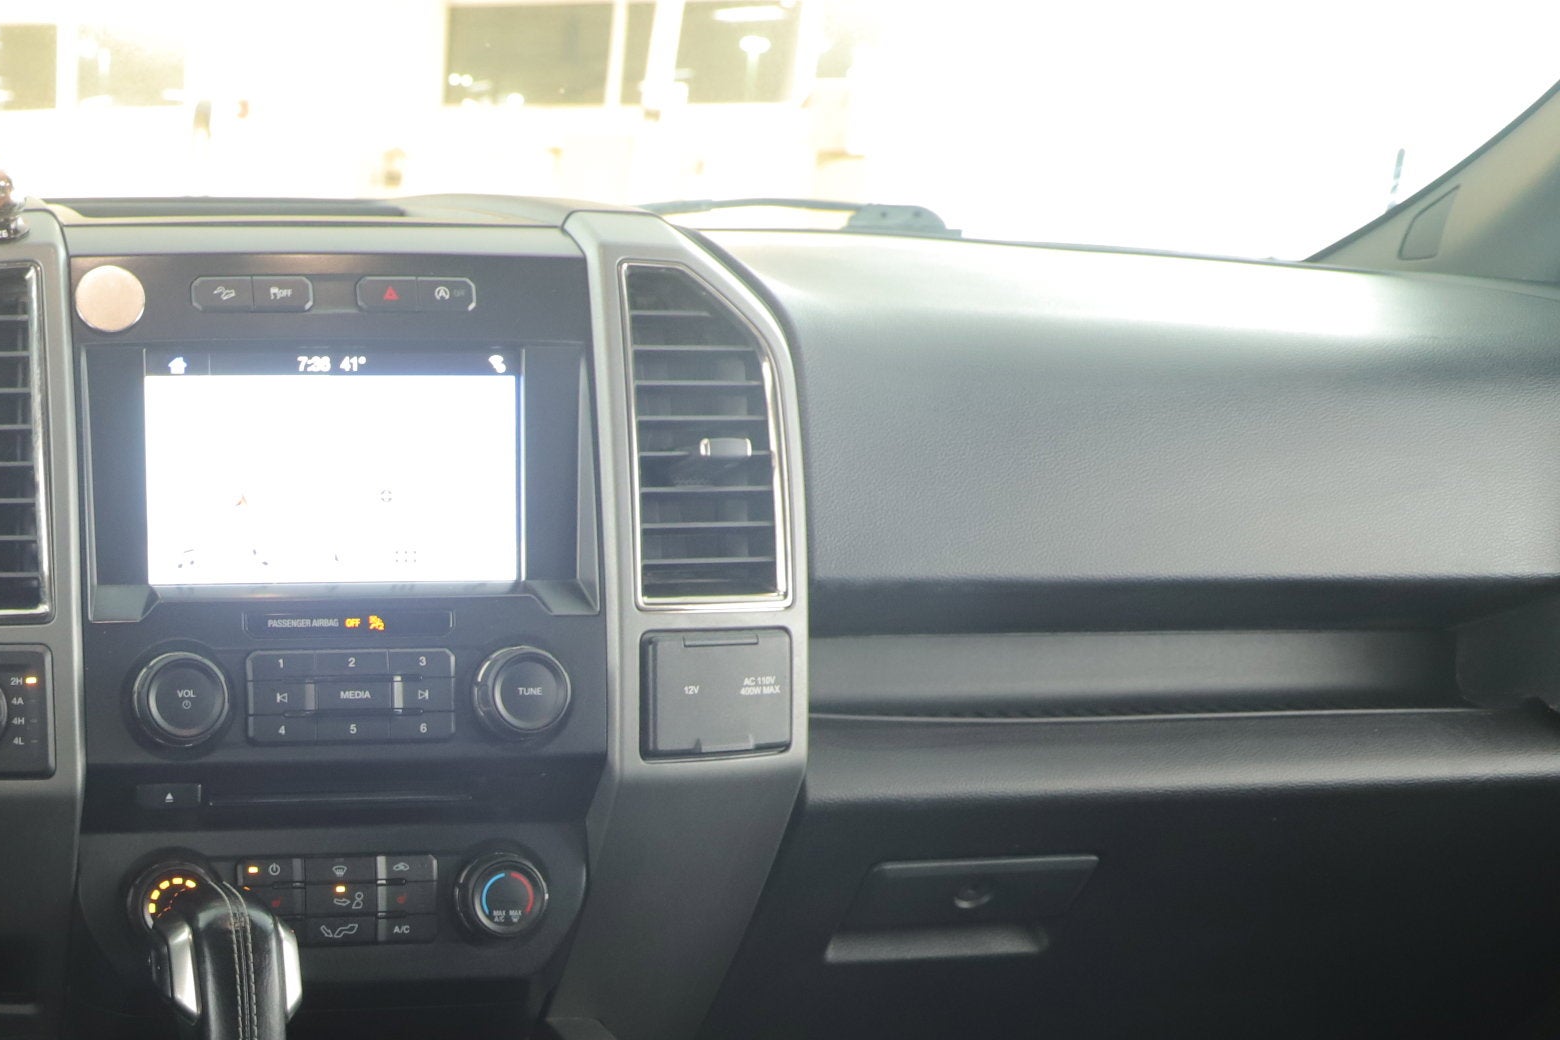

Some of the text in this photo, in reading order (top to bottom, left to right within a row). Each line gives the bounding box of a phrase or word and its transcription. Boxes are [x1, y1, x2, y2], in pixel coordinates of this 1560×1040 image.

[279, 288, 292, 298] OFF
[267, 618, 361, 628] PASSENGER AIRBAG OFF
[278, 658, 284, 668] 1
[348, 657, 355, 667] 2
[419, 656, 426, 666] 3
[10, 677, 22, 685] 2H
[743, 676, 776, 686] AC 110V
[177, 689, 196, 698] VOL
[340, 690, 371, 699] MEDIA
[517, 687, 542, 695] TUNE
[684, 685, 699, 695] 12V
[740, 685, 781, 695] 400W MAX
[11, 697, 24, 705] 4A
[11, 717, 25, 725] 4H
[278, 725, 285, 735] 4
[350, 724, 357, 734] 5
[420, 723, 427, 733] 6
[13, 737, 25, 745] 4L
[393, 925, 410, 934] A/C
